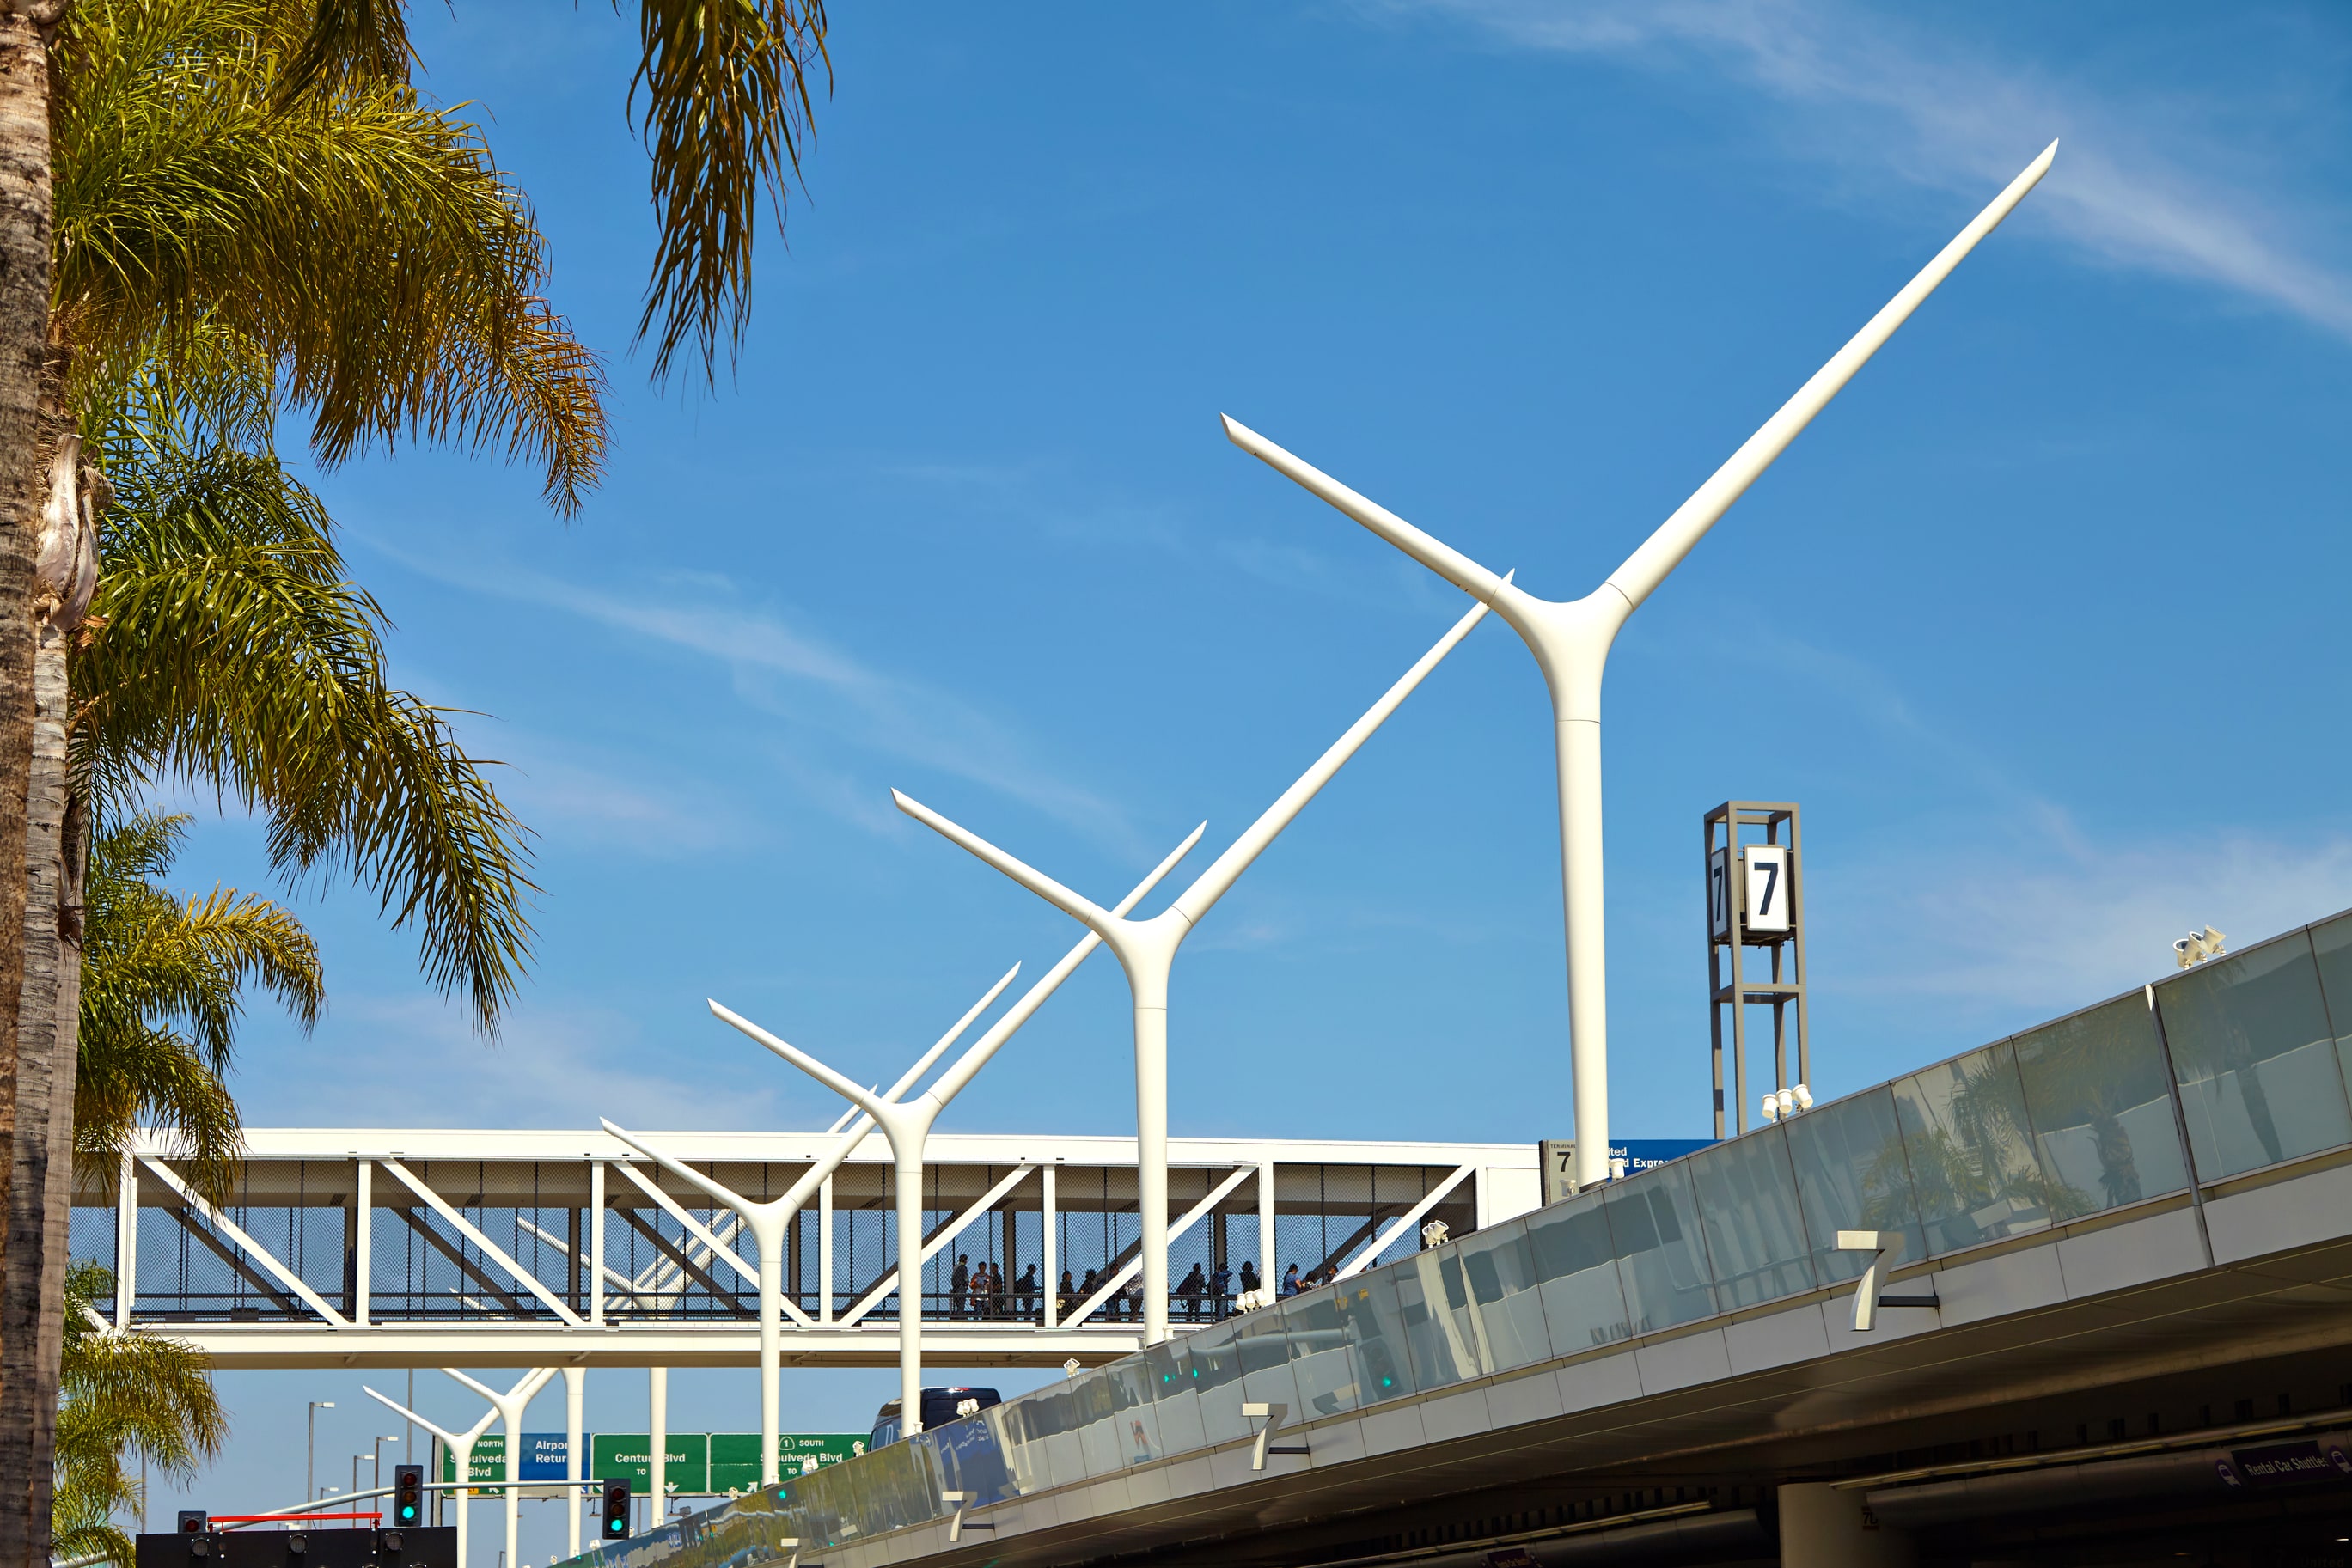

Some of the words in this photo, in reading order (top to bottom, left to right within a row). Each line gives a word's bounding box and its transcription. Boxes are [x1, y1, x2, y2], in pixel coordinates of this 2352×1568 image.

[1714, 865, 1723, 922] 7
[1754, 862, 1779, 915] 7
[1609, 1147, 1628, 1156] ited
[1556, 1151, 1571, 1173] 7
[1633, 1157, 1669, 1168] Expre
[535, 1440, 568, 1452] Airpor
[449, 1454, 507, 1463] Sulveda
[535, 1453, 568, 1463] Retur
[614, 1453, 651, 1463] Centur
[664, 1453, 686, 1463] Blvd
[760, 1453, 817, 1463] ulveda
[819, 1453, 843, 1463] Blvd
[2244, 1461, 2277, 1476] Rental
[2274, 1459, 2294, 1473] Car
[2290, 1455, 2330, 1471] Shuttles
[468, 1467, 492, 1477] Blvd
